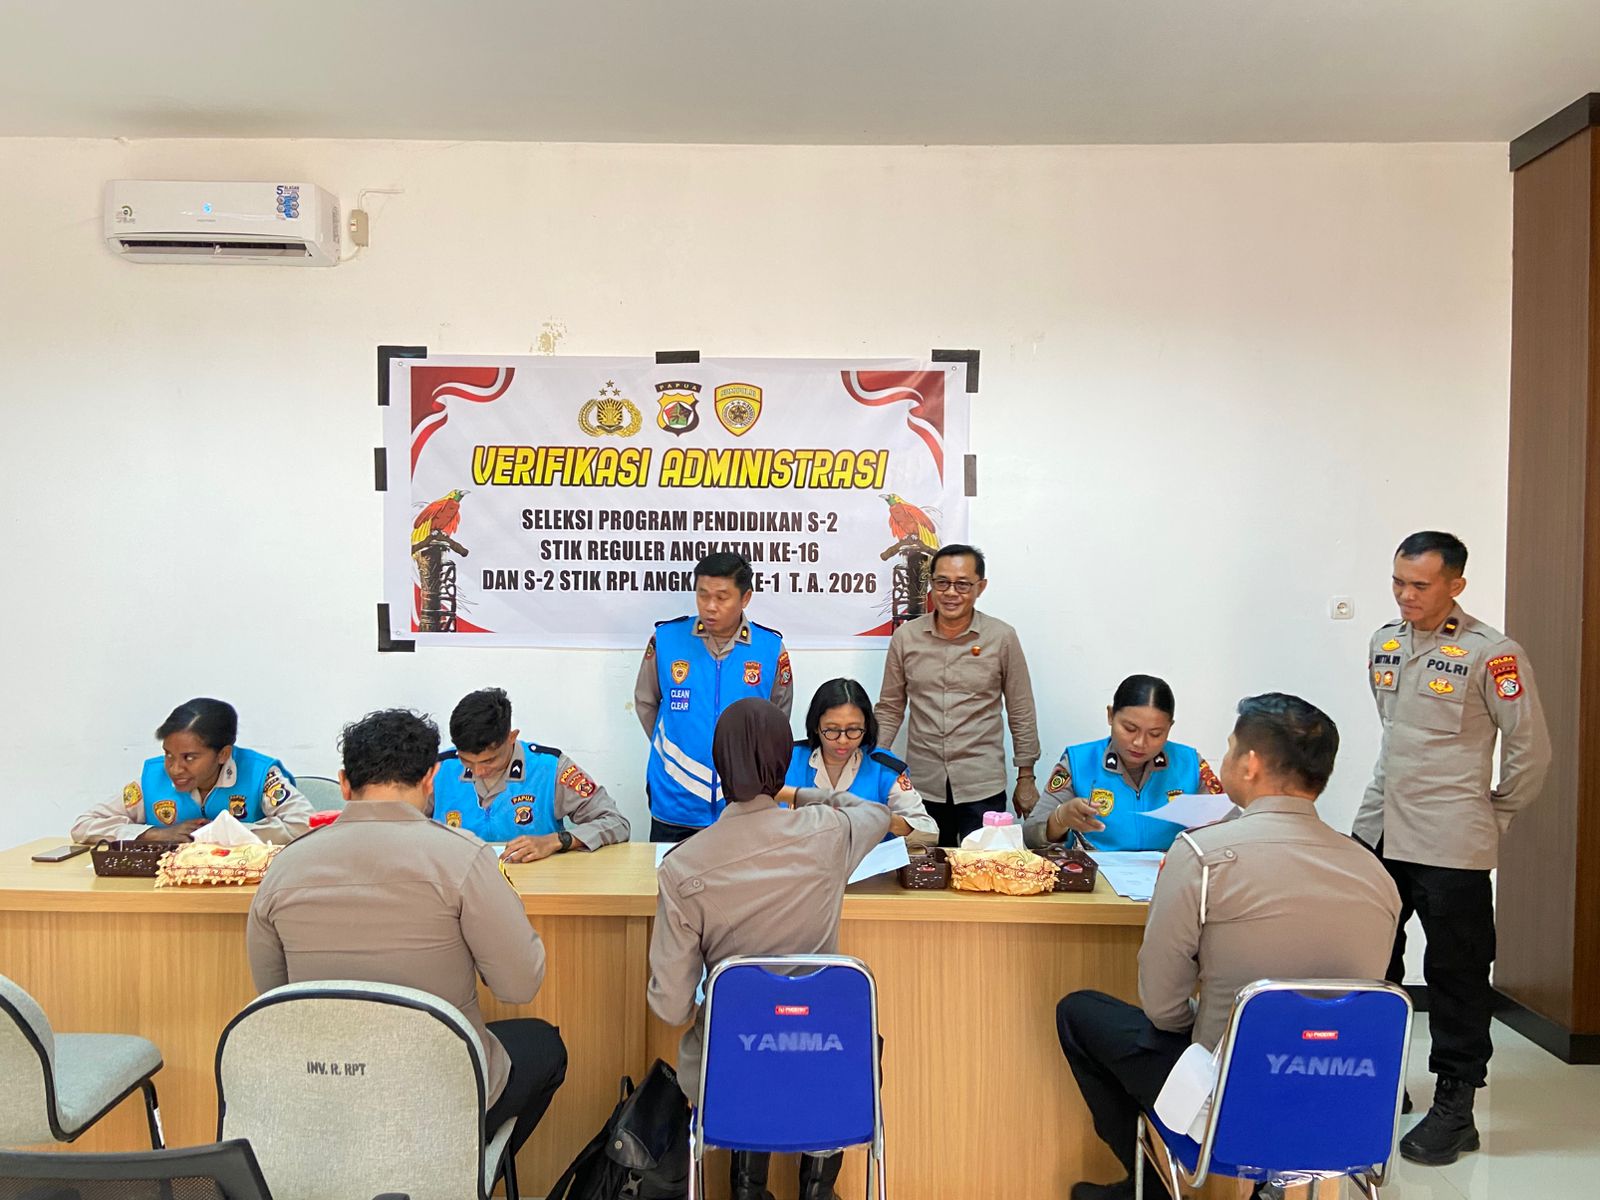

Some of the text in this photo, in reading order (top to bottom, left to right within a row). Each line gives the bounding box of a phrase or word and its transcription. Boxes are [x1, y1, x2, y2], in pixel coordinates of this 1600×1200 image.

[659, 382, 697, 391] PAPUA
[472, 445, 889, 489] VERIFIKASI ADMINISTRASI
[522, 509, 838, 532] SELEKSI PROGRAM PENDIDIKAN S-2
[540, 540, 582, 560] STIK
[587, 541, 665, 561] REGULER
[769, 542, 819, 562] KE-16
[482, 570, 519, 590] DAN
[524, 570, 555, 590] S-2
[560, 570, 601, 591] STIK
[606, 571, 639, 591] RPL
[643, 571, 696, 592] ANGK
[829, 573, 877, 593] 2026
[1426, 658, 1468, 676] POLRI
[1489, 656, 1514, 667] POLDA
[671, 689, 690, 698] CLEAN
[671, 702, 689, 710] CLEAR
[738, 1032, 844, 1052] YANMA
[307, 1061, 367, 1076] INV. R. RPT
[1266, 1054, 1377, 1077] YANMA
